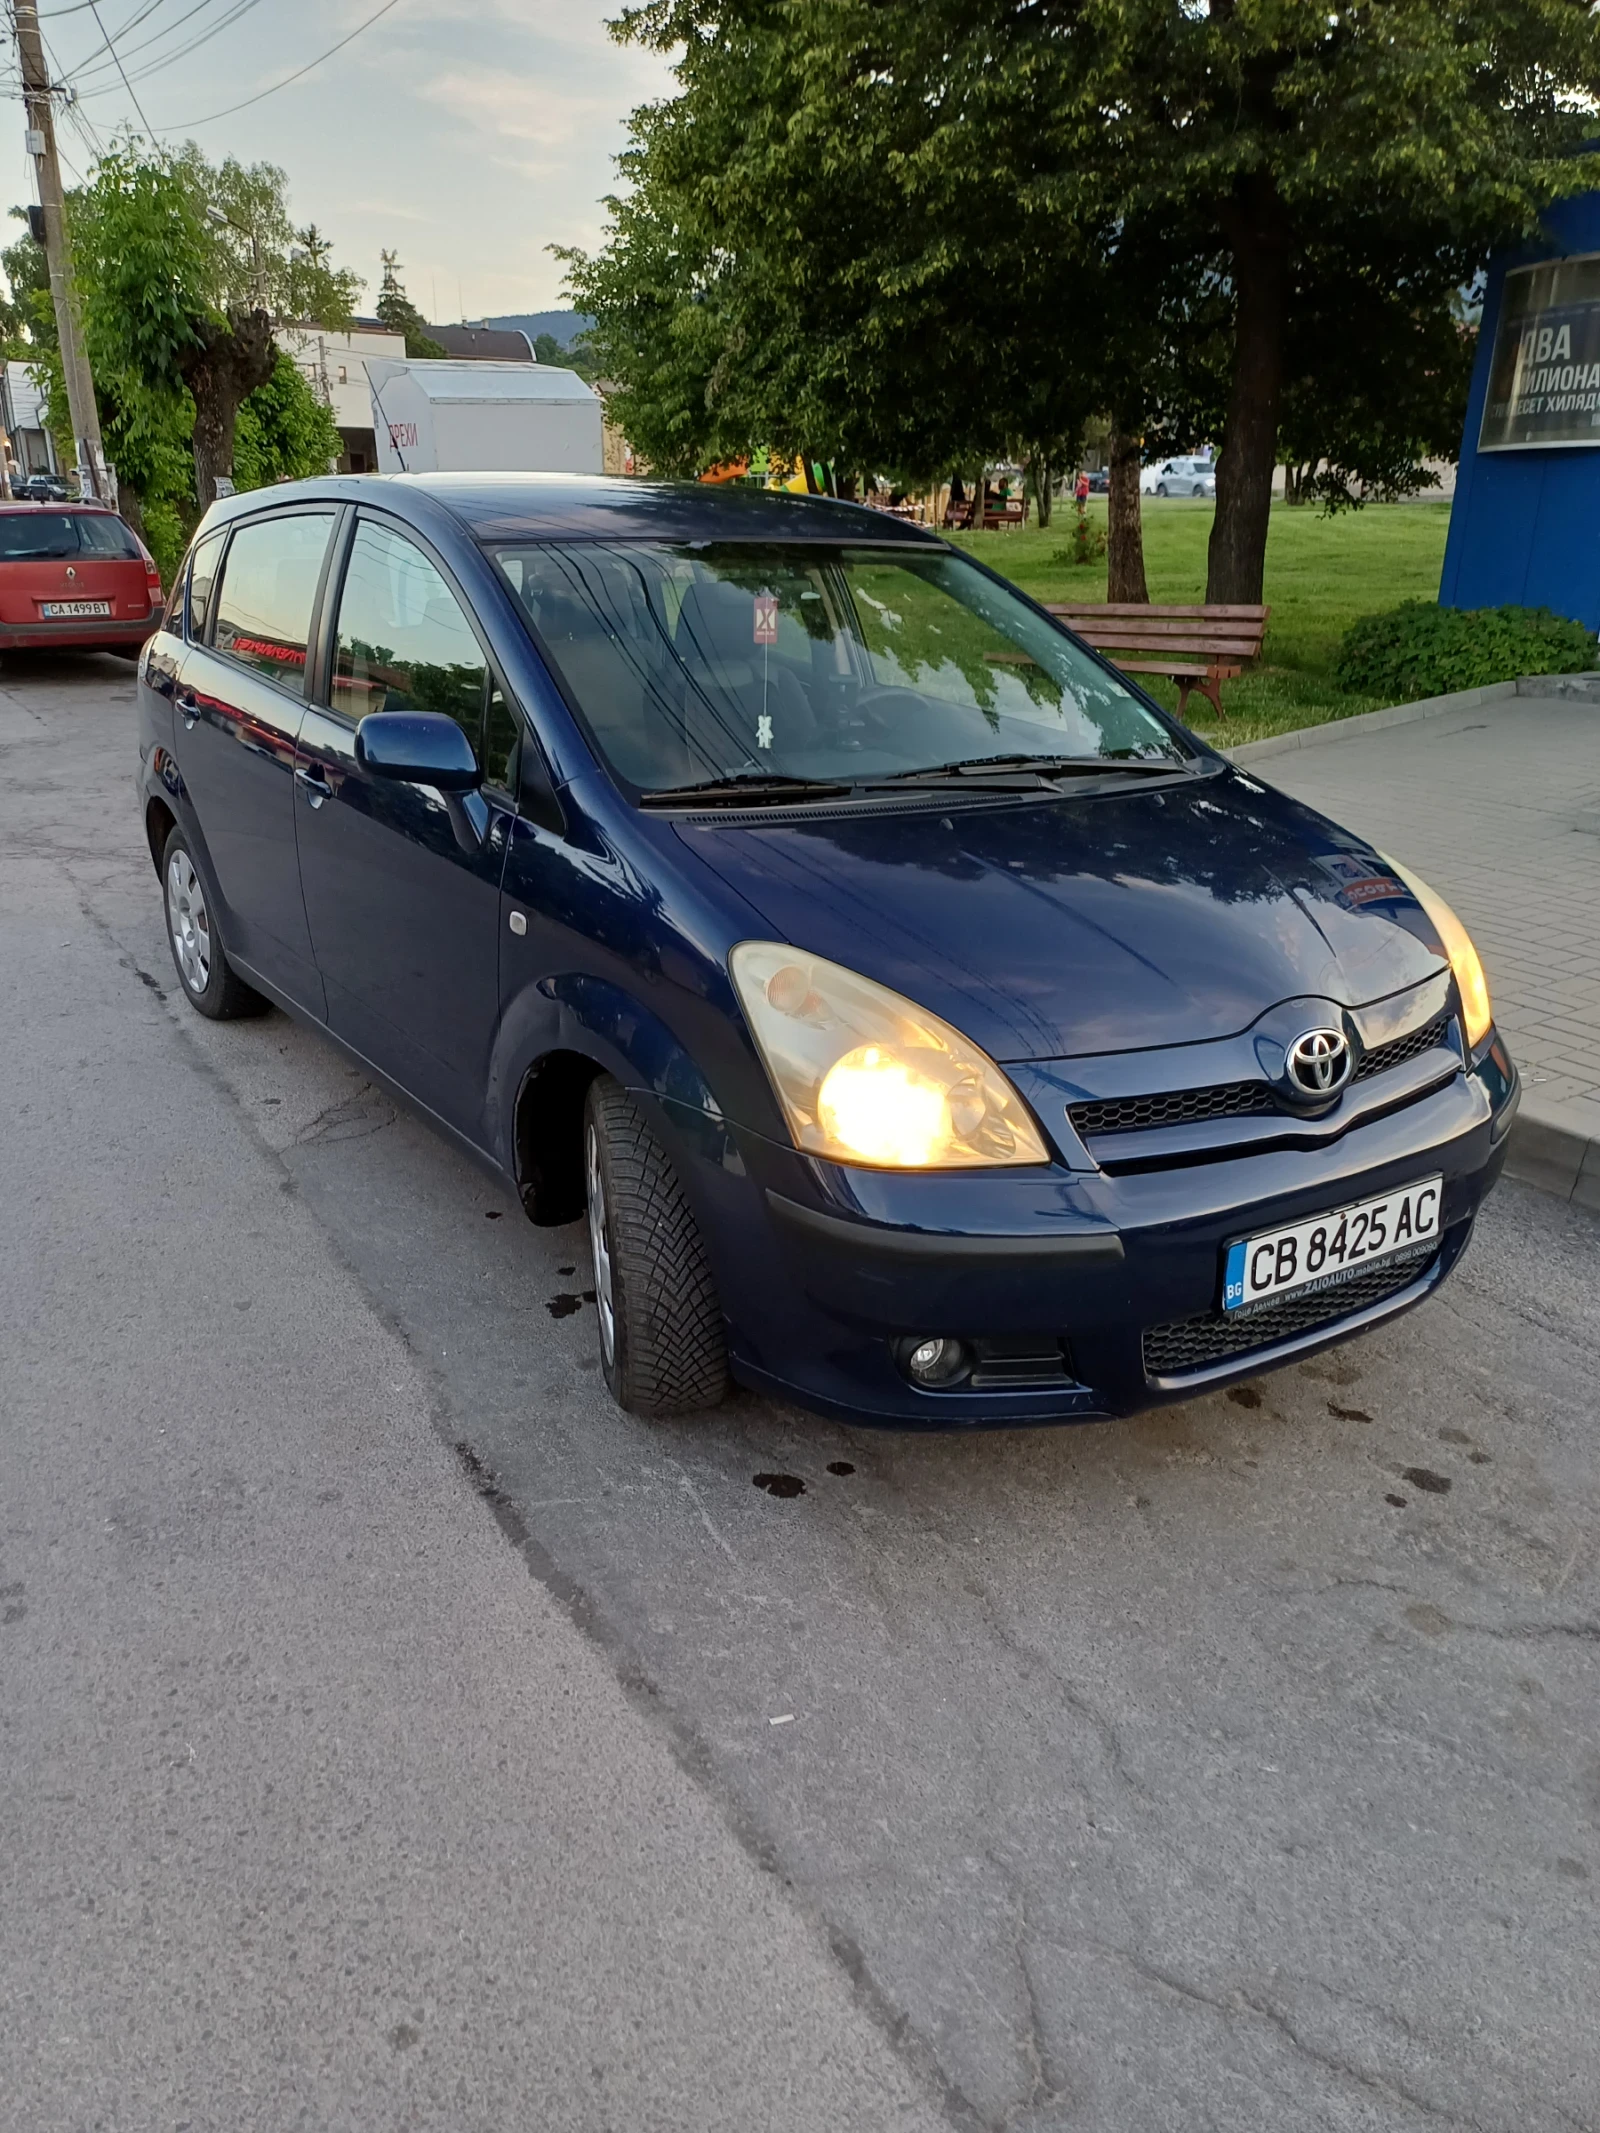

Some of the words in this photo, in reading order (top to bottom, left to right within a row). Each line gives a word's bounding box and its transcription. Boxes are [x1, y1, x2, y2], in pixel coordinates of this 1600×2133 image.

[1521, 324, 1571, 368] ДВА
[50, 603, 66, 615] CA
[67, 603, 92, 615] 1499
[94, 602, 107, 614] BT
[1250, 1236, 1298, 1291] CB
[1306, 1204, 1389, 1273] 8425
[1393, 1188, 1436, 1244] AC
[1226, 1281, 1243, 1300] BG
